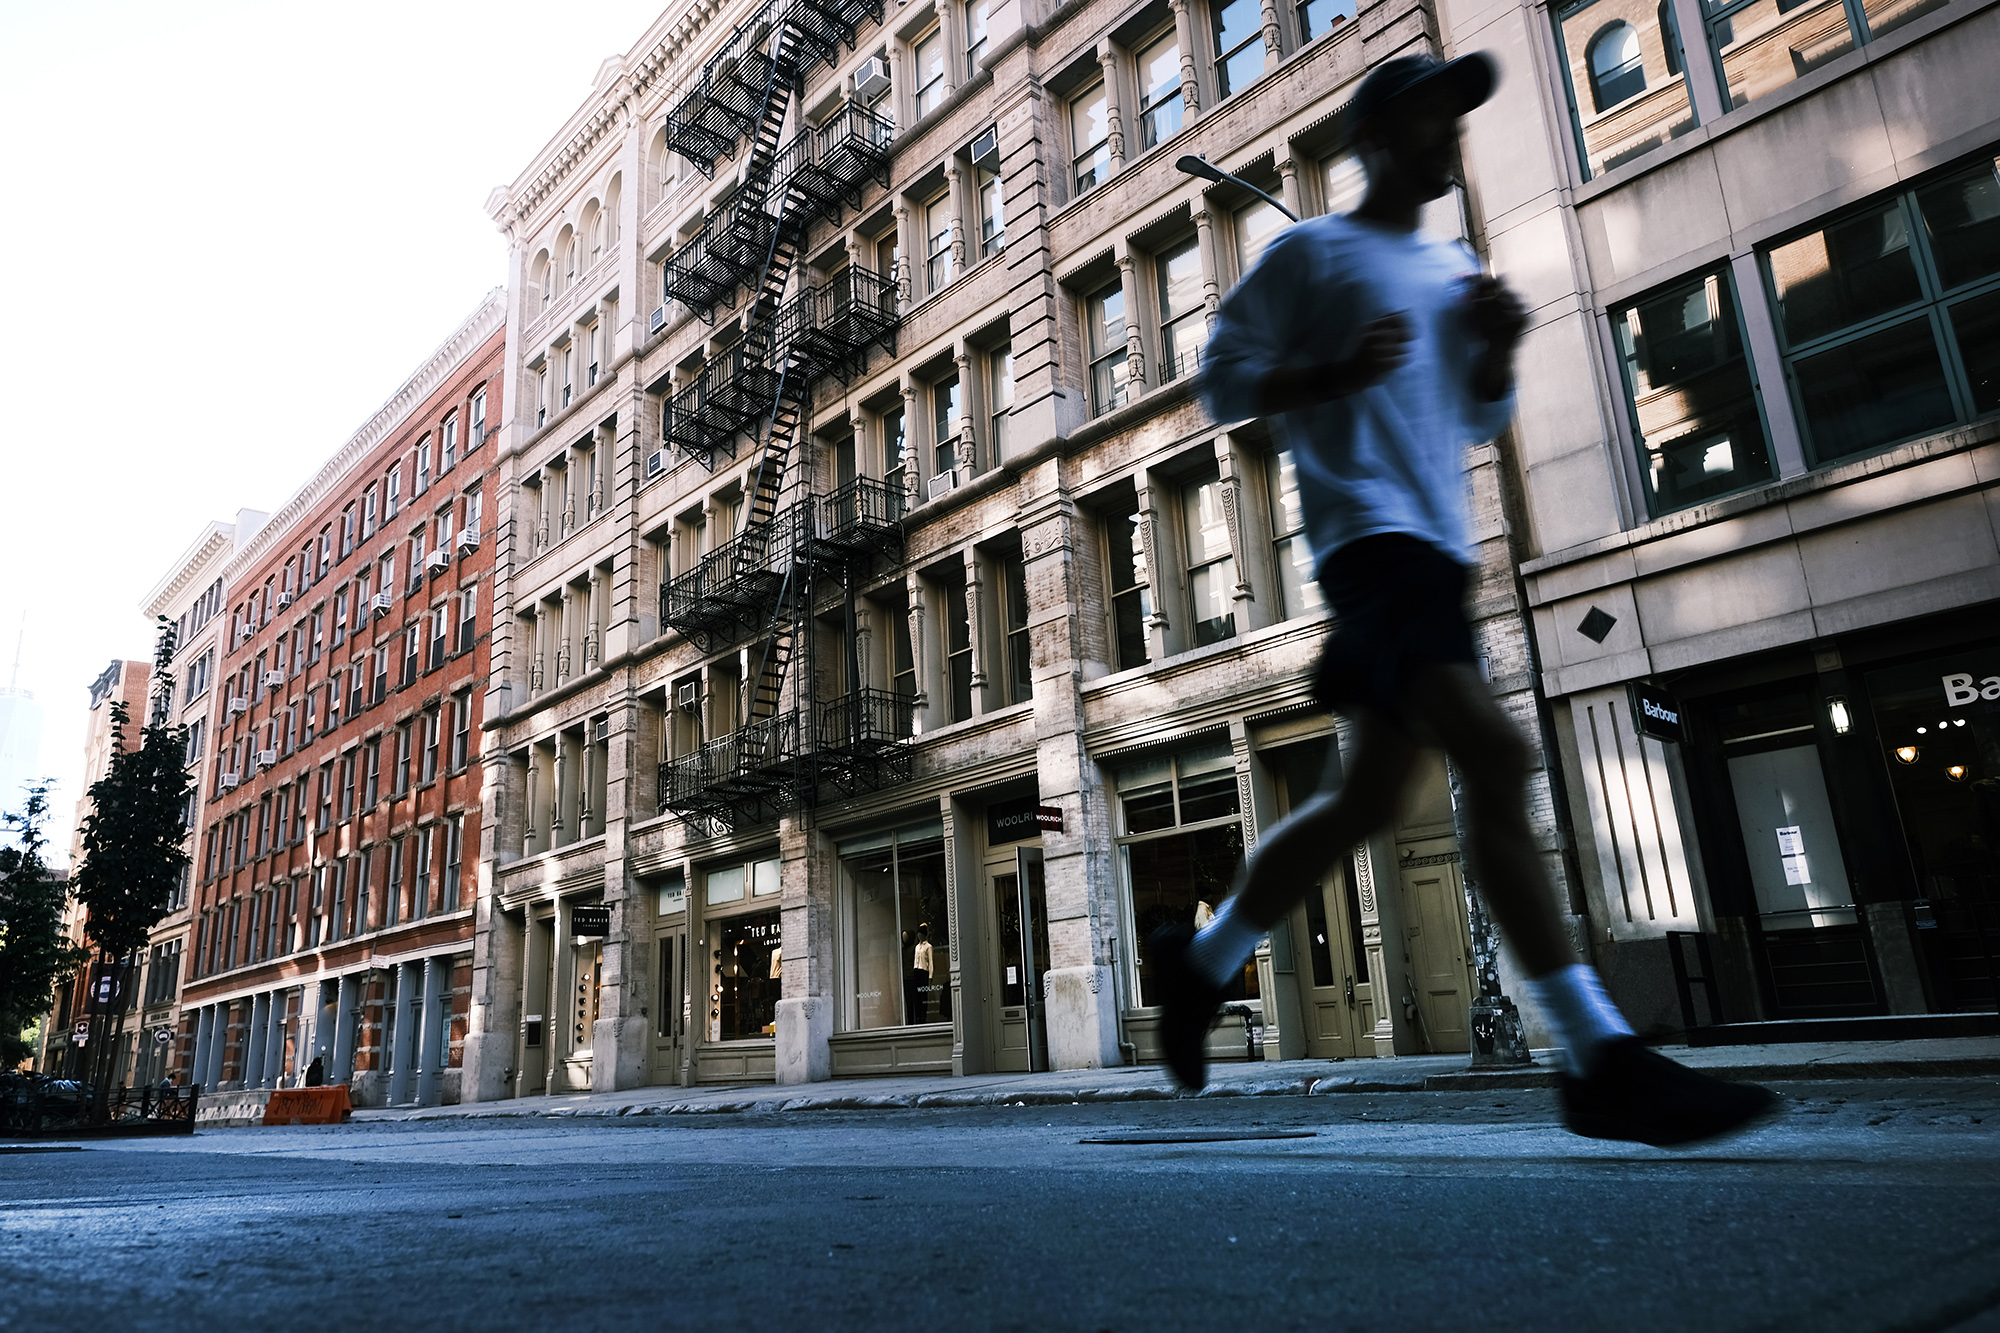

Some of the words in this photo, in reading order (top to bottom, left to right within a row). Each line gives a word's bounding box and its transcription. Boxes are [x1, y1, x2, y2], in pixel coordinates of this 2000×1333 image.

[1941, 672, 2000, 707] Ba
[1642, 698, 1678, 724] Barbour
[996, 811, 1034, 828] WOOLRI
[1035, 814, 1062, 823] WOOLRICH
[751, 926, 766, 938] TED
[916, 984, 944, 993] WOOLRICH
[856, 991, 882, 999] WOOLRICH
